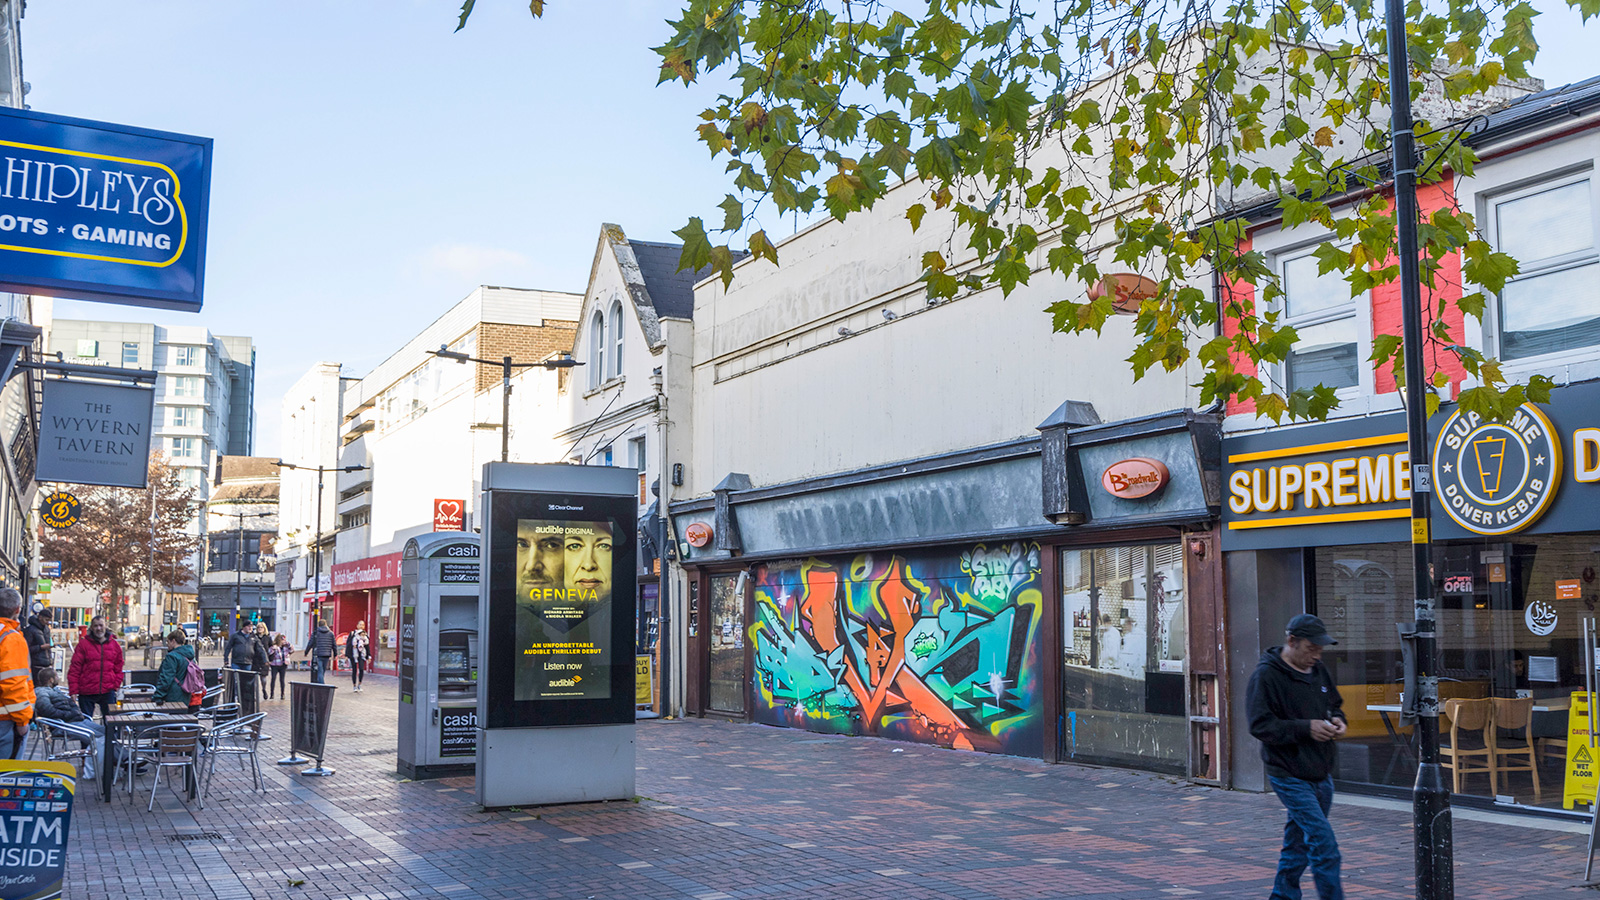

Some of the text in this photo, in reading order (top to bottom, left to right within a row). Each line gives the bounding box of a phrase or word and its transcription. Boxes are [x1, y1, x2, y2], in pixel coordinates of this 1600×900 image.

[0, 157, 175, 226] HIPLEYS
[72, 223, 171, 251] GAMING
[84, 402, 112, 415] THE
[52, 415, 141, 436] WYVERN
[1445, 410, 1541, 450] SUPME
[54, 436, 134, 456] TAVERN
[1229, 451, 1412, 514] SUPREME
[1445, 478, 1543, 525] DONER KEBAB
[42, 513, 77, 528] LOUNGE
[535, 525, 595, 535] audible ORIGINAL
[448, 545, 478, 556] cash
[1444, 581, 1472, 592] OPEN
[529, 588, 599, 602] GENEVA
[544, 662, 565, 670] Listen
[549, 678, 575, 687] audible
[443, 712, 477, 726] cash
